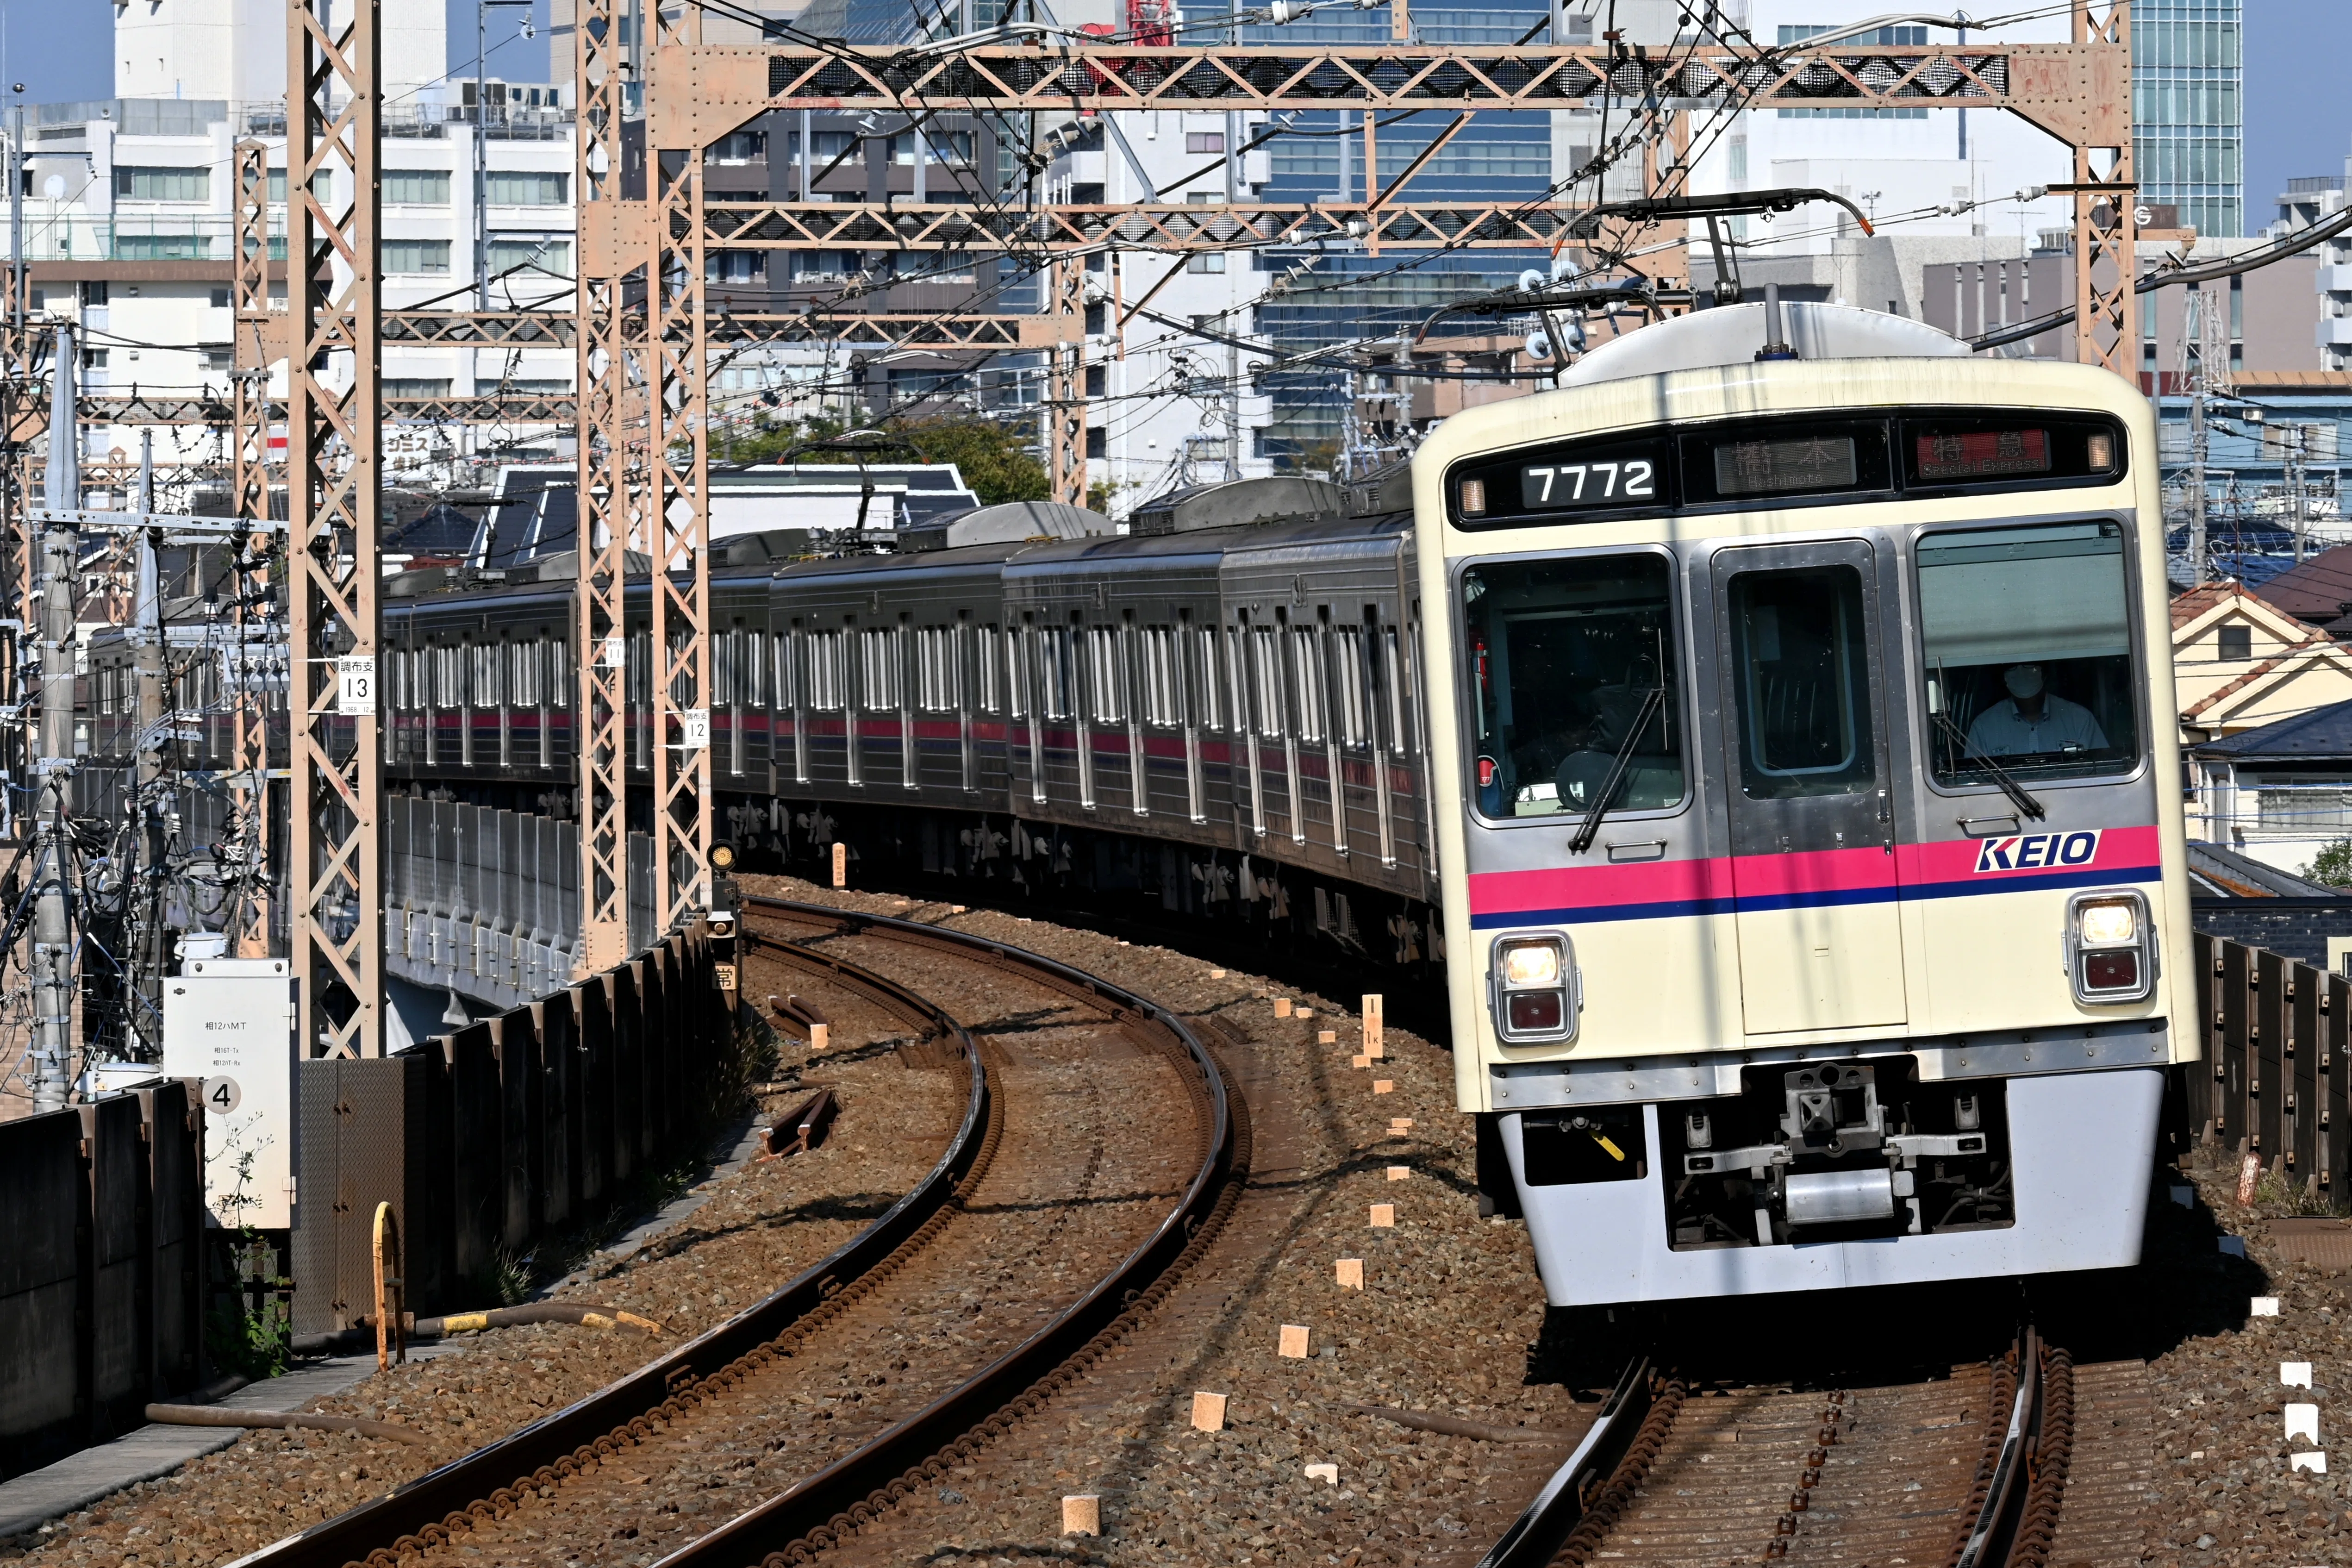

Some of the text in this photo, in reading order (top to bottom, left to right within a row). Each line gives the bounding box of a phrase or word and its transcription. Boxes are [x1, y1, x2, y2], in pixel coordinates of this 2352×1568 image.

[1923, 459, 2039, 475] Special Express
[1528, 461, 1653, 501] 7772
[1748, 474, 1822, 488] Hashimoto
[340, 661, 373, 672] 調布支
[348, 678, 367, 697] 13
[691, 724, 704, 737] 12
[1978, 832, 2096, 871] KEIO
[715, 968, 732, 987] 常
[212, 1084, 231, 1106] 4
